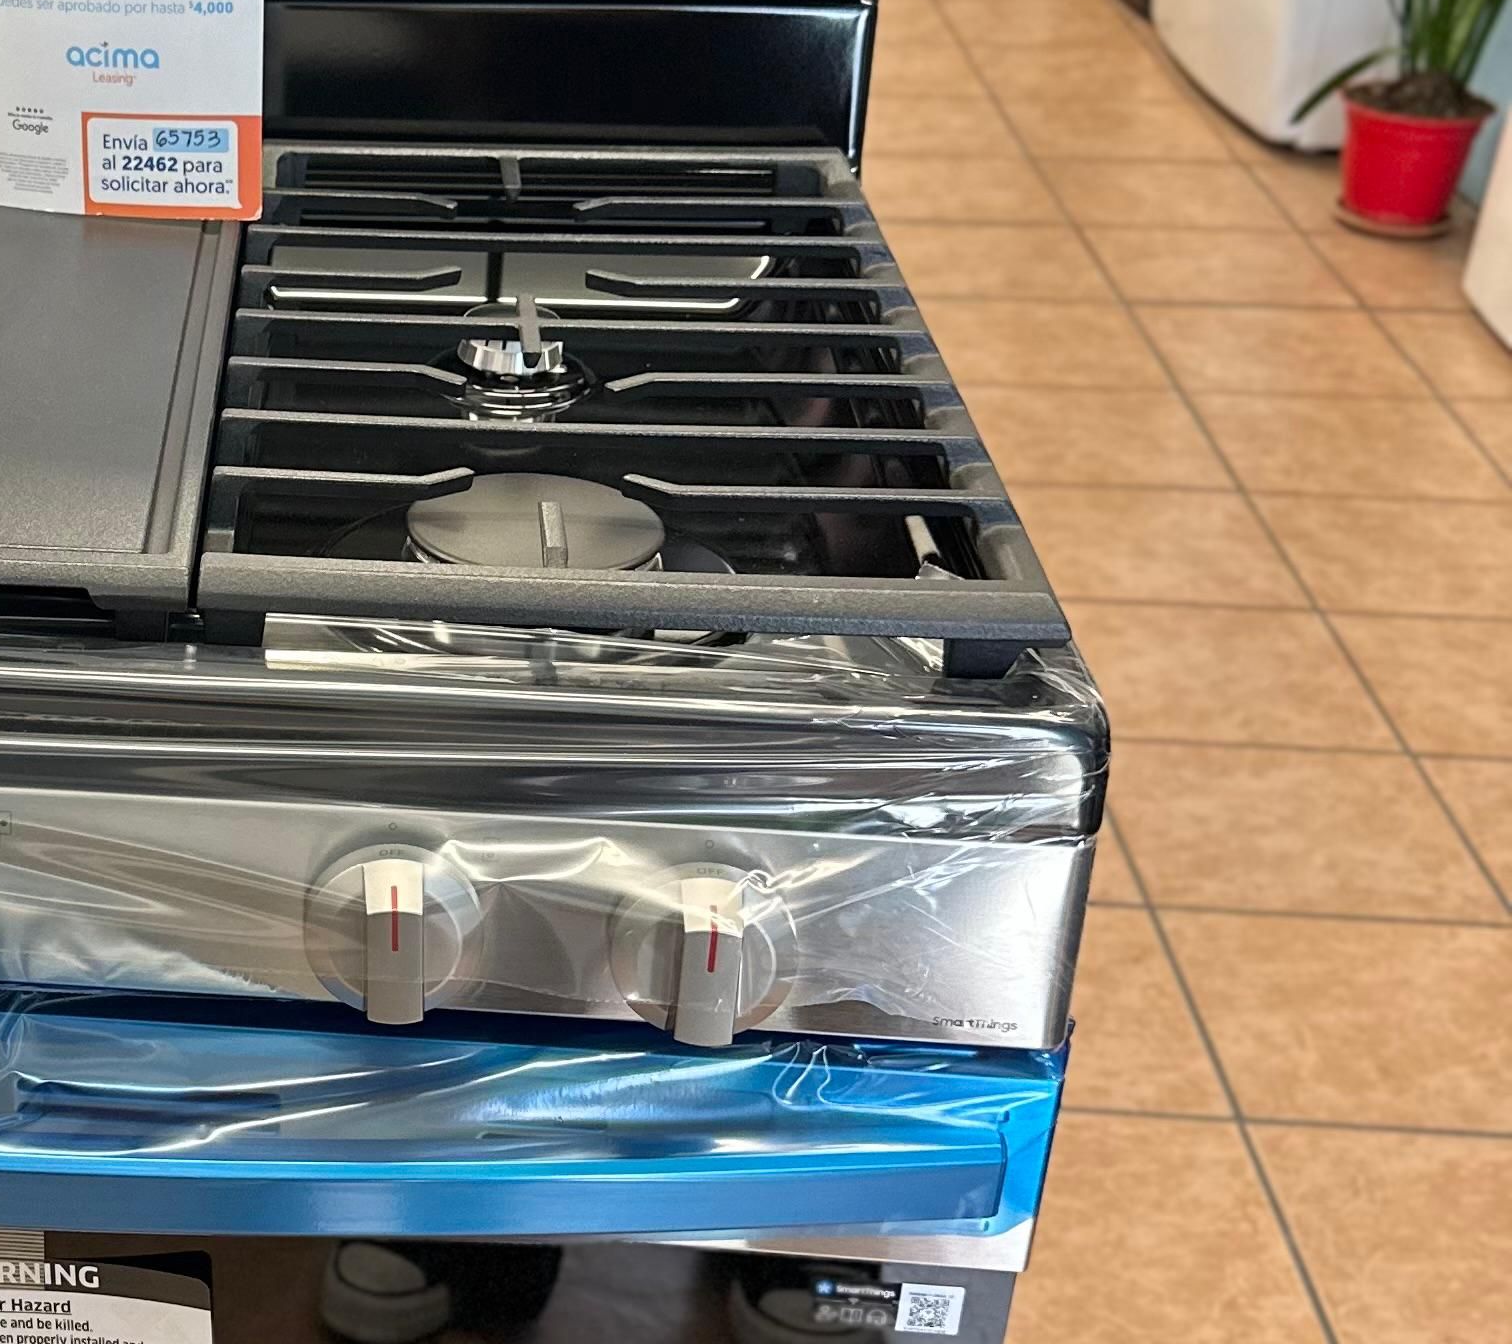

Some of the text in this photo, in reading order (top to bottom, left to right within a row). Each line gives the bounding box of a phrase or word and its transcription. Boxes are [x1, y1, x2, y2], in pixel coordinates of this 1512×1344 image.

[36, 0, 54, 10] ser
[57, 0, 121, 14] aprobado
[124, 2, 147, 16] por
[150, 2, 185, 14] hasta
[188, 1, 234, 16] $4,000
[65, 41, 160, 69] acima
[92, 71, 135, 87] Leasing
[12, 119, 49, 136] Google
[102, 134, 148, 151] Envía
[155, 130, 222, 148] 65753
[102, 155, 223, 175] al 22462 para
[101, 176, 168, 193] solicitar
[11, 1299, 71, 1313] Hazard
[10, 1317, 33, 1330] and
[37, 1318, 52, 1330] be
[55, 1319, 93, 1333] killed.
